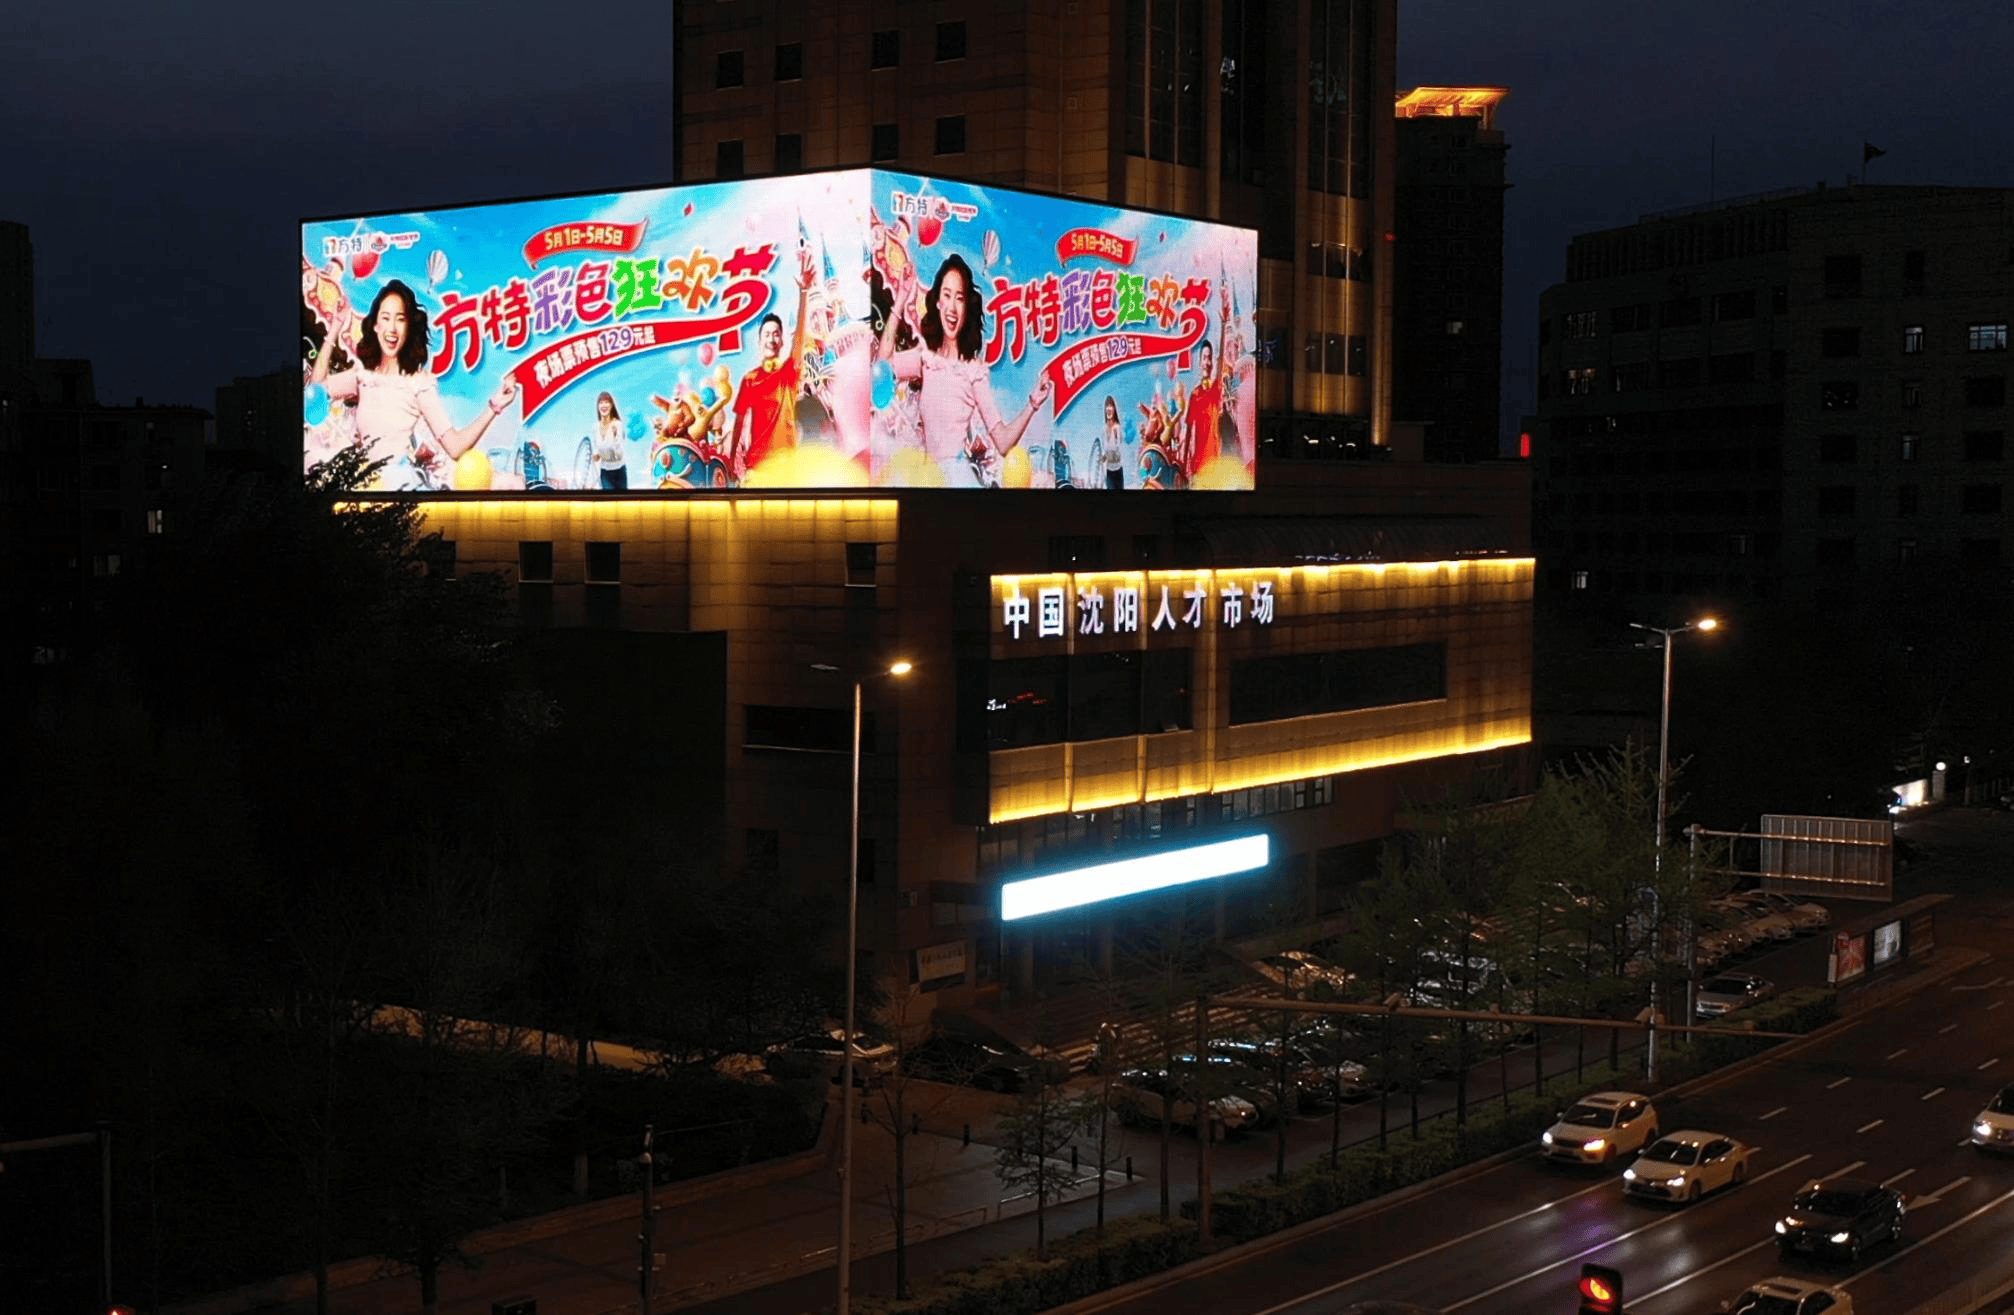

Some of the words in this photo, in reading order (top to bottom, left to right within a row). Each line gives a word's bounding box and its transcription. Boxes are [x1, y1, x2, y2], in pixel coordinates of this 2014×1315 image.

[545, 226, 624, 250] 5月1日-5月5日
[431, 243, 777, 374] 方特彩色狂欢节
[985, 270, 1210, 369] 方特彩色狂欢节
[1003, 581, 1275, 639] 中国沈阳人才市场
